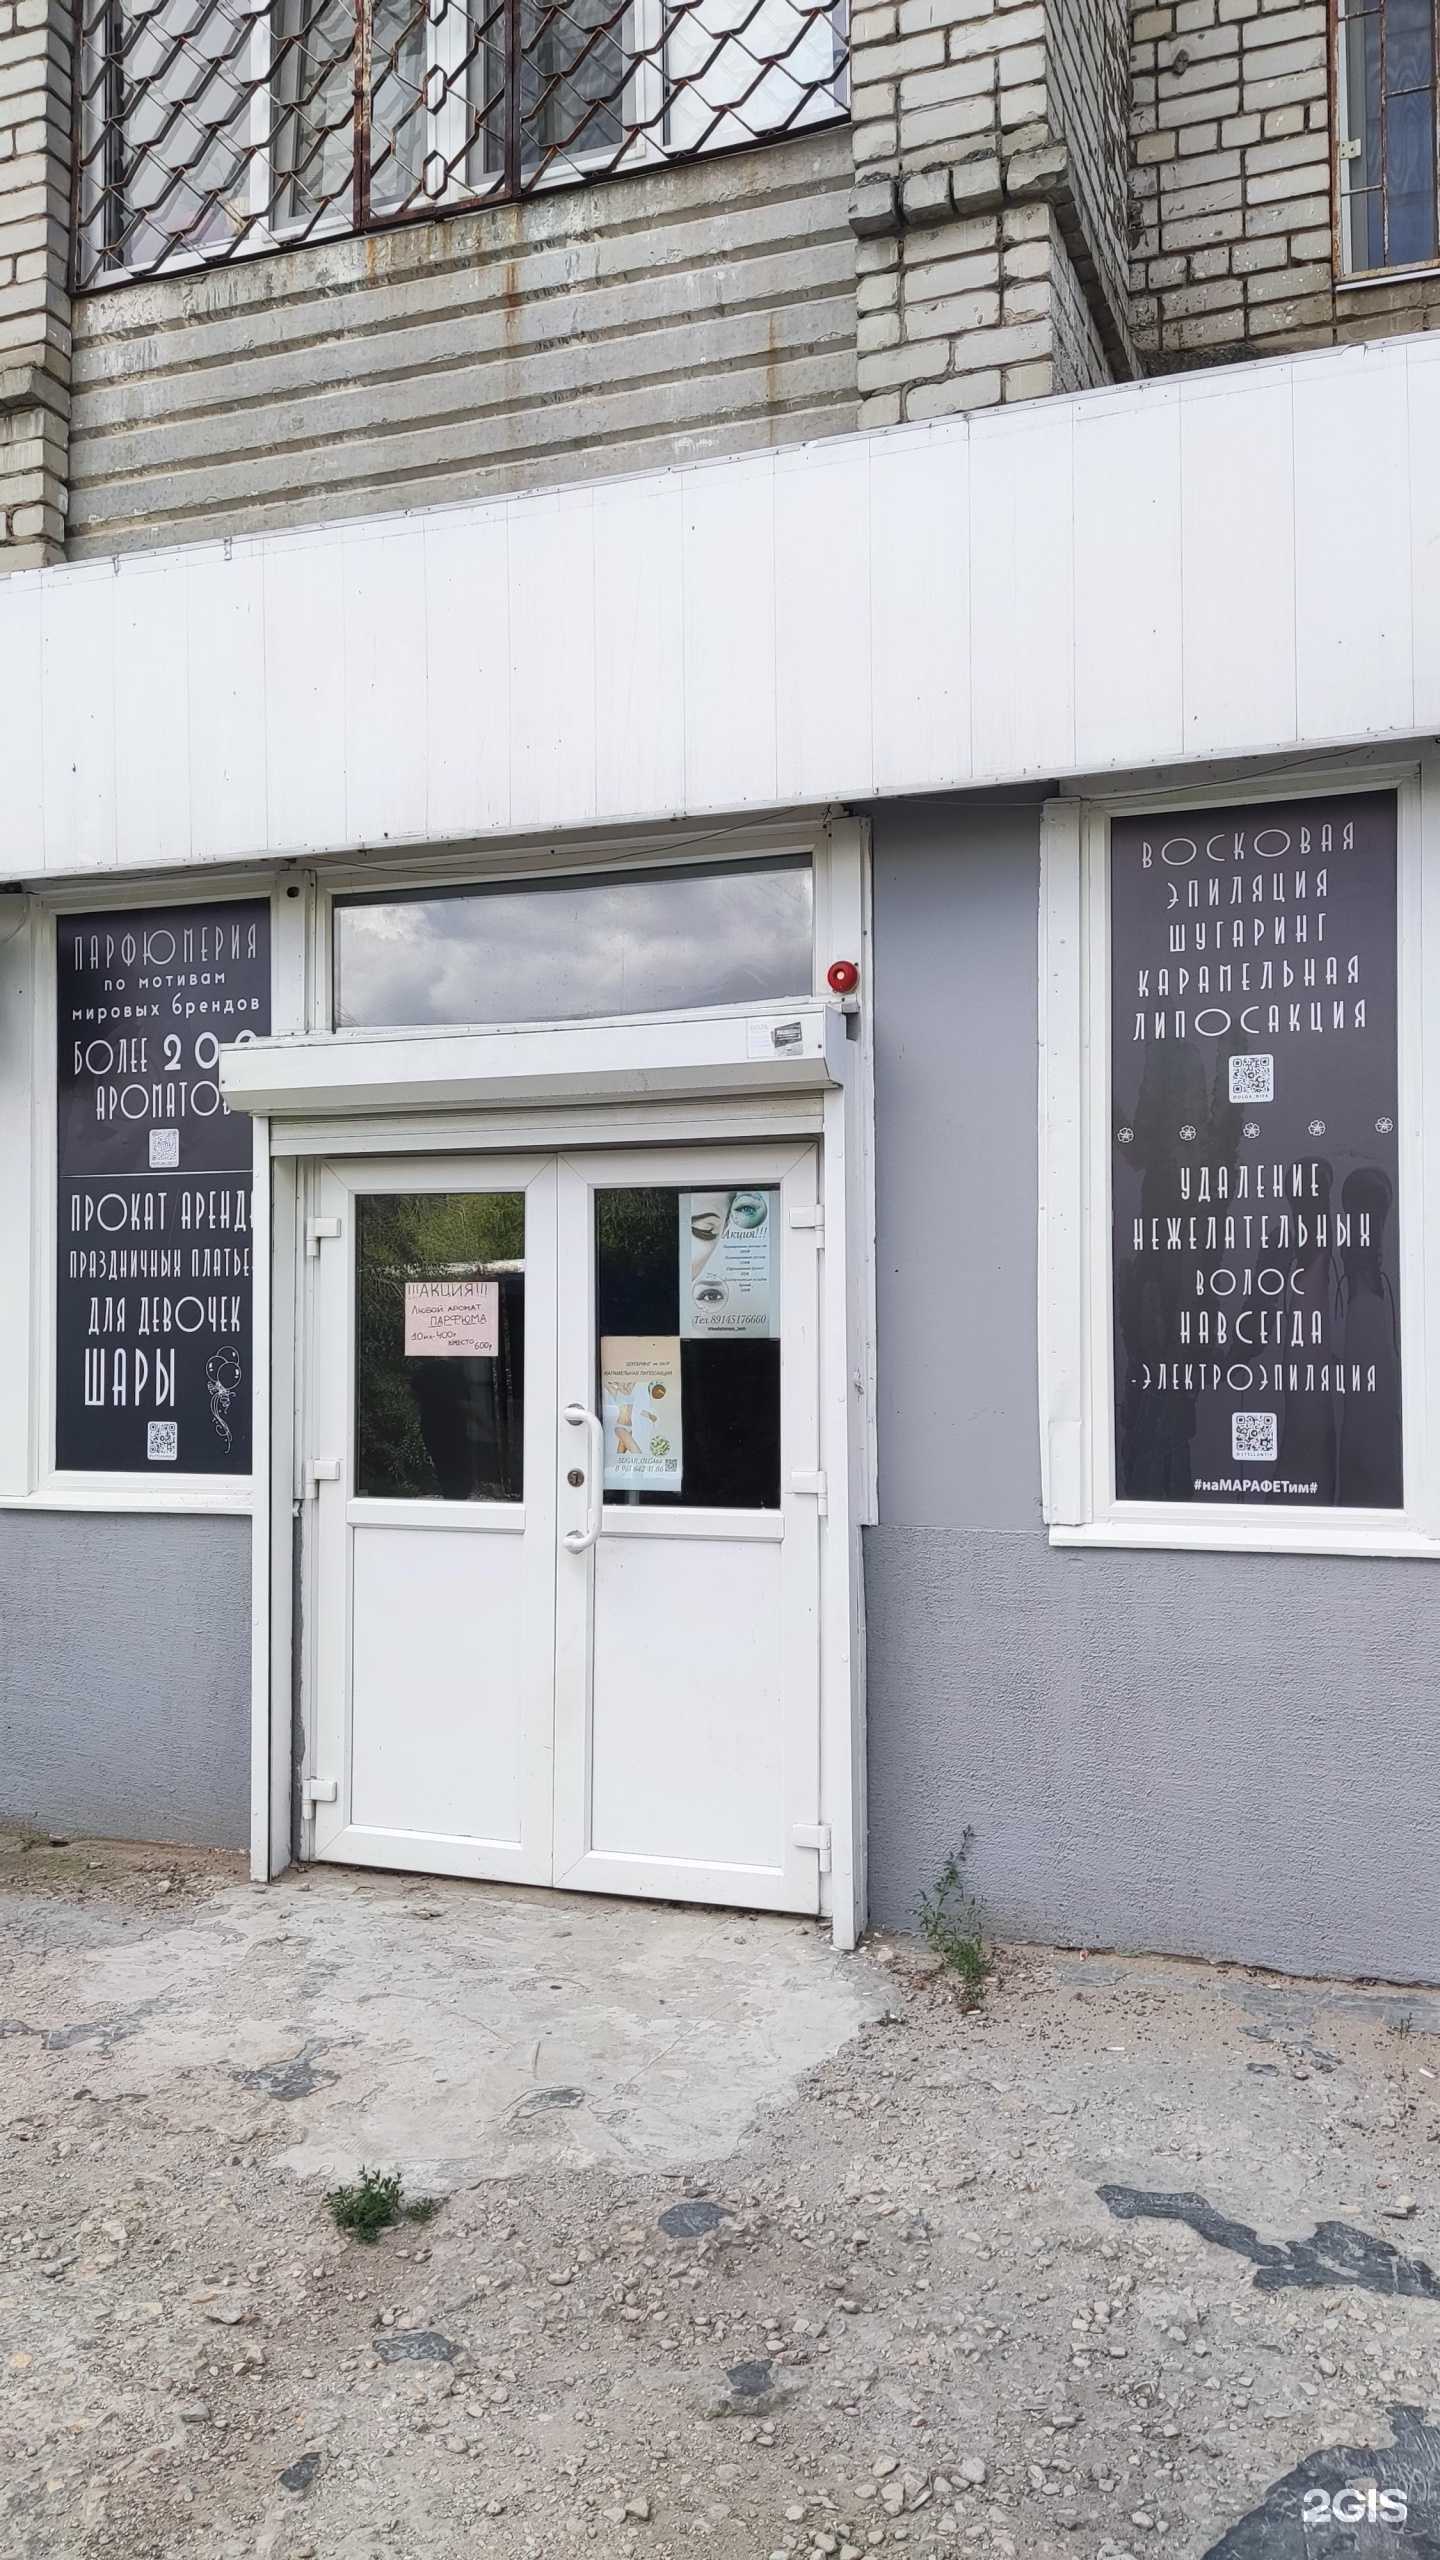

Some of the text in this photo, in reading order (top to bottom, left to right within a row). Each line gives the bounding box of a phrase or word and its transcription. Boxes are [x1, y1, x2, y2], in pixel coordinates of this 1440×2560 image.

[1142, 821, 1354, 869] ВОСКОВАЯ
[1167, 868, 1328, 910] ЭПИЛЯЦИЯ
[74, 923, 256, 971] ПАРФЮМЕРИЯ
[1169, 913, 1327, 952] ШУГАРИНГ
[104, 972, 225, 991] по мотивам
[1137, 954, 1359, 998] КАРАМЕЛЬНАЯ
[72, 993, 260, 1024] мировых брендов
[1133, 999, 1366, 1041] ЛИПОСАКЦИЯ
[74, 1037, 148, 1075] БОЛЕЕ
[1180, 1163, 1320, 1202] УДАЛЕНИЕ
[71, 1190, 253, 1232] ПРОКАТ АРЕНД
[1133, 1212, 1371, 1251] НЕЖЕЛАТЕЛЬНЫХ
[69, 1247, 253, 1280] ПРАЗДНИЧНЫХ ПЛАТЬЕ
[1196, 1268, 1305, 1296] ВОЛОС
[88, 1295, 241, 1335] ДЛЯ ДЕВОЧЕК
[1180, 1310, 1323, 1347] НАВСЕГДА
[84, 1348, 175, 1407] ШАРЫ
[1194, 1478, 1318, 1494] #наМАРАФЕТим#
